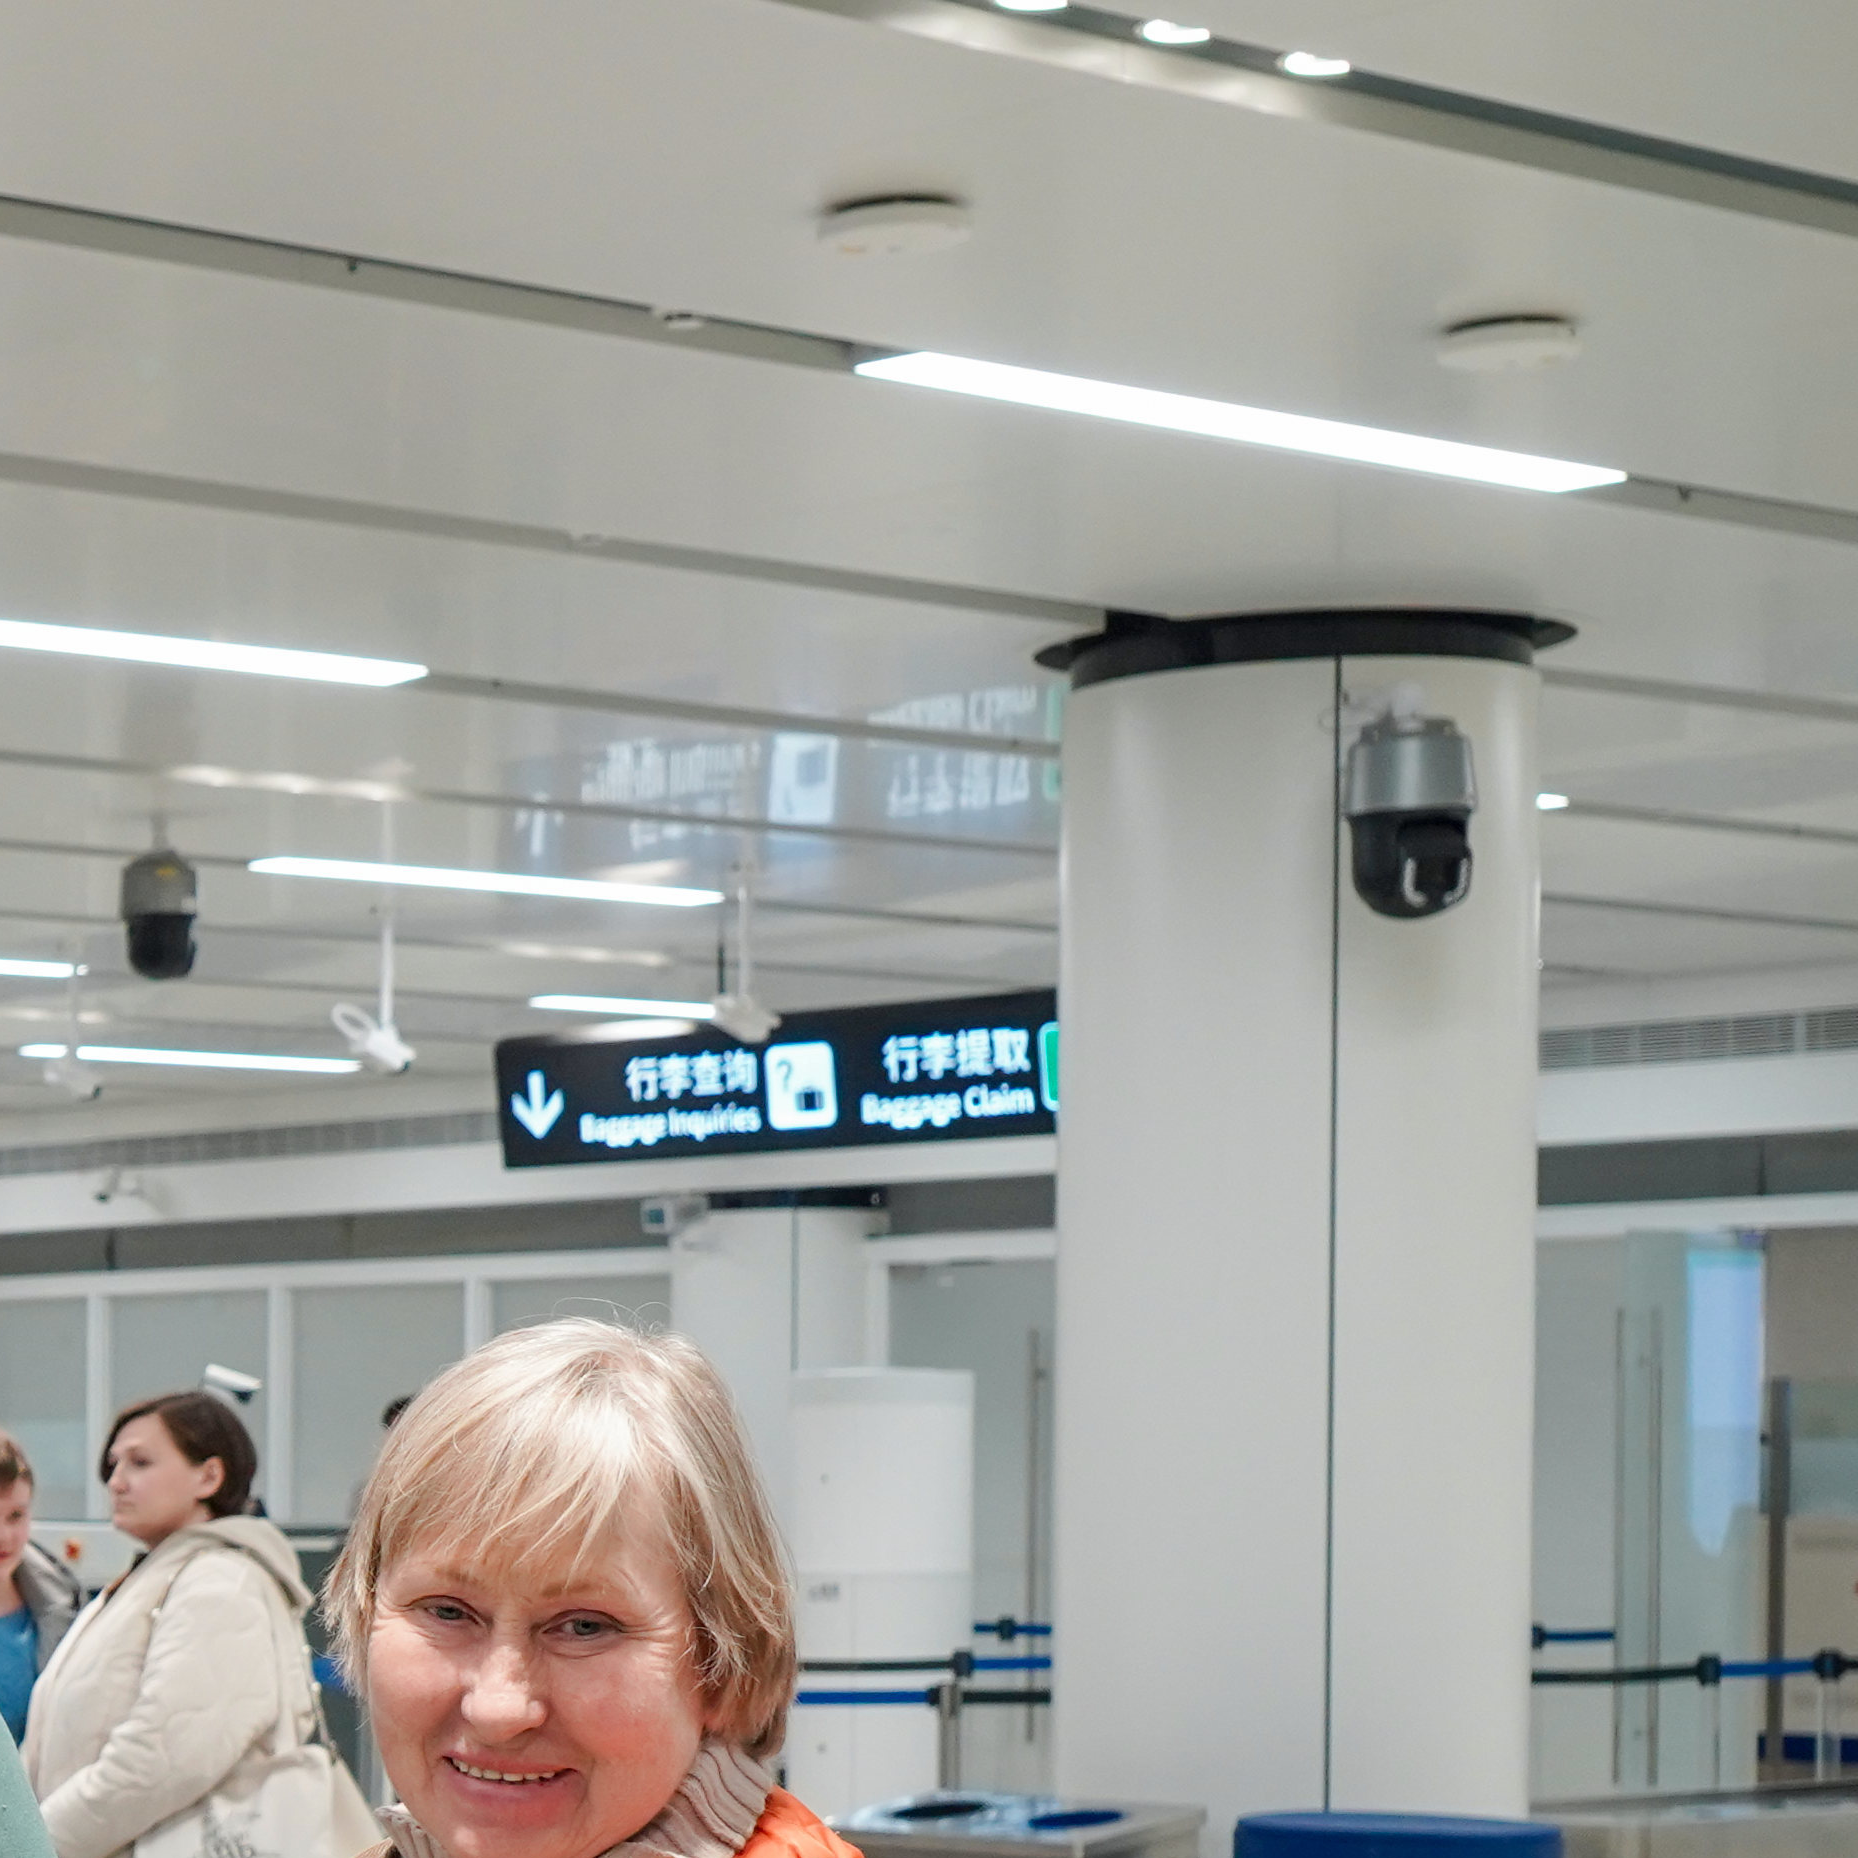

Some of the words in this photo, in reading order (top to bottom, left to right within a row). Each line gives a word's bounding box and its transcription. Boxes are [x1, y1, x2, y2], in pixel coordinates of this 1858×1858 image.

[623, 1050, 759, 1103] 行李查询
[881, 1027, 1032, 1084] 行李提取
[860, 1091, 963, 1130] Baggage
[963, 1082, 1035, 1118] Claim
